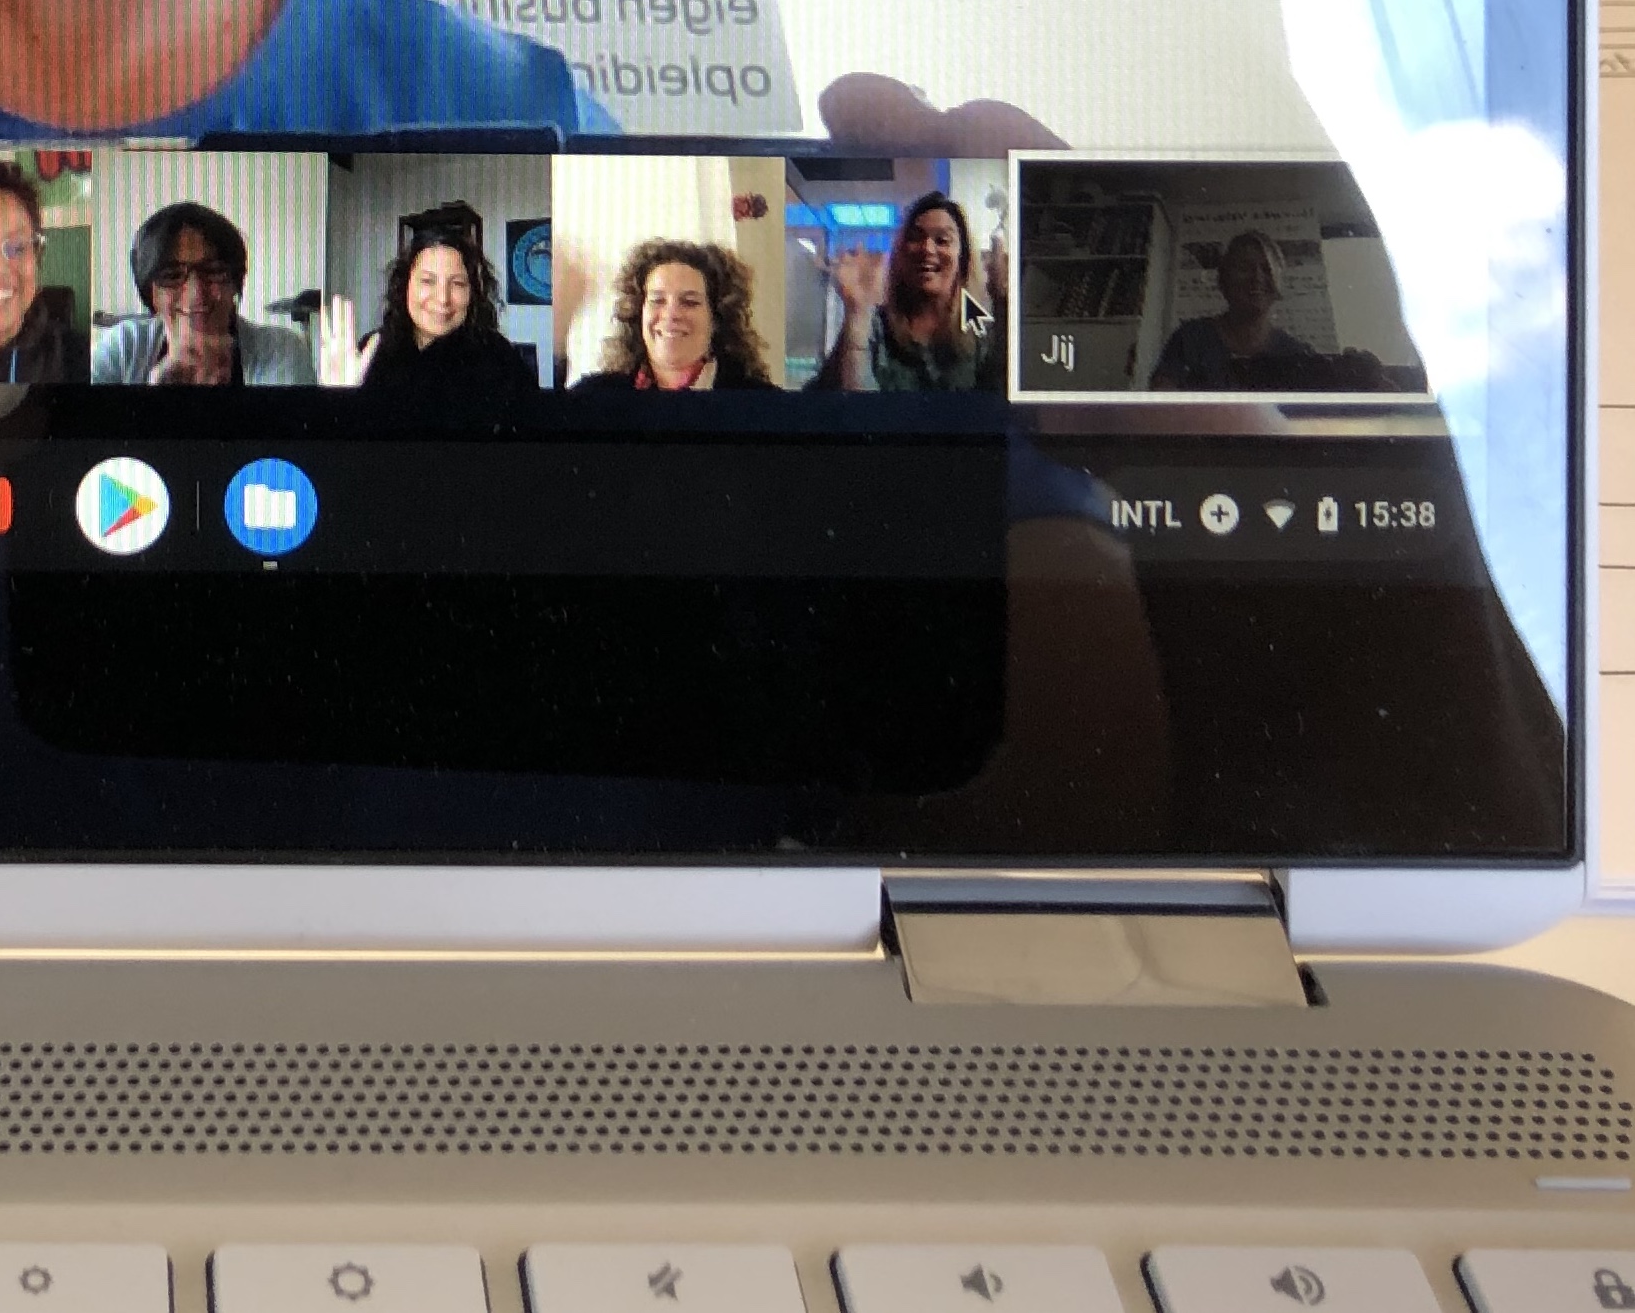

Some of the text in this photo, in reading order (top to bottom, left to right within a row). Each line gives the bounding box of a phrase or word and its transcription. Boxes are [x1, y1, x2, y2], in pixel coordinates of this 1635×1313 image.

[1039, 334, 1076, 372] Jij
[1111, 500, 1437, 529] INTL 15:38
